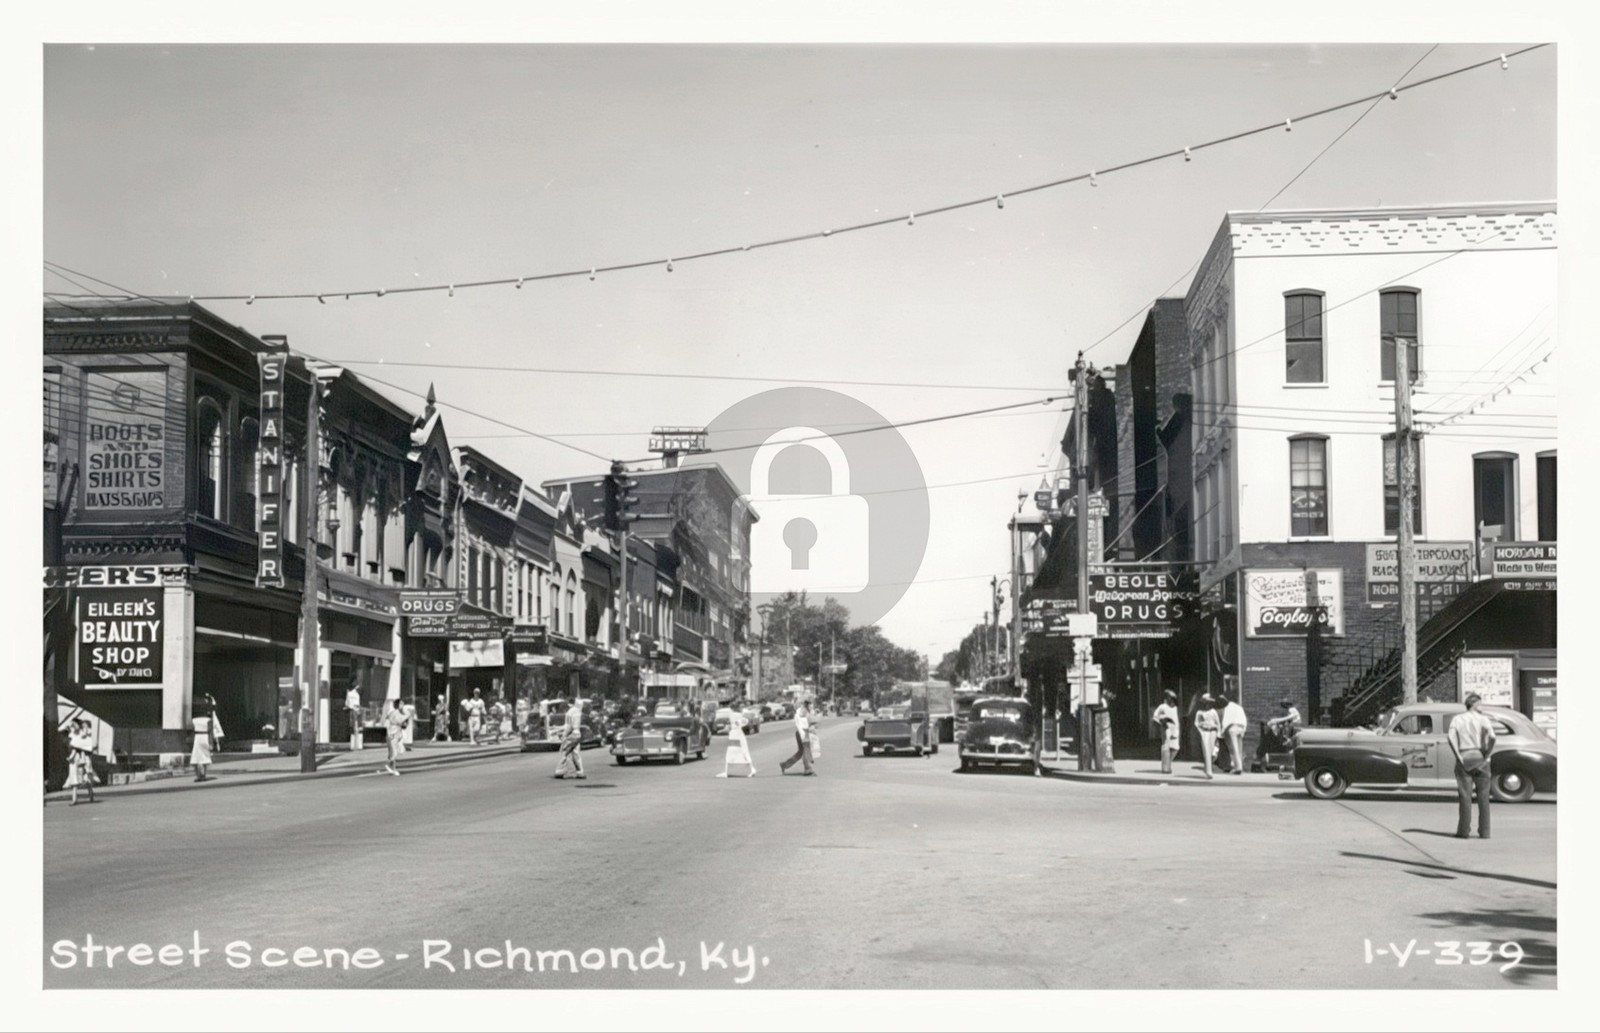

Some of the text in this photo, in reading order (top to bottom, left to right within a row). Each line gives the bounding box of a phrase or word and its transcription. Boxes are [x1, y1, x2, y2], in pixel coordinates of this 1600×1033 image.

[89, 453, 163, 470] SHOES
[261, 363, 279, 577] STANIFER
[89, 471, 161, 488] SHIRTS
[88, 598, 156, 616] EILEEN'S
[401, 600, 455, 612] DRUGS
[1104, 604, 1183, 619] DRUGS
[82, 620, 160, 643] BEAUTY
[92, 647, 149, 664] SHOP
